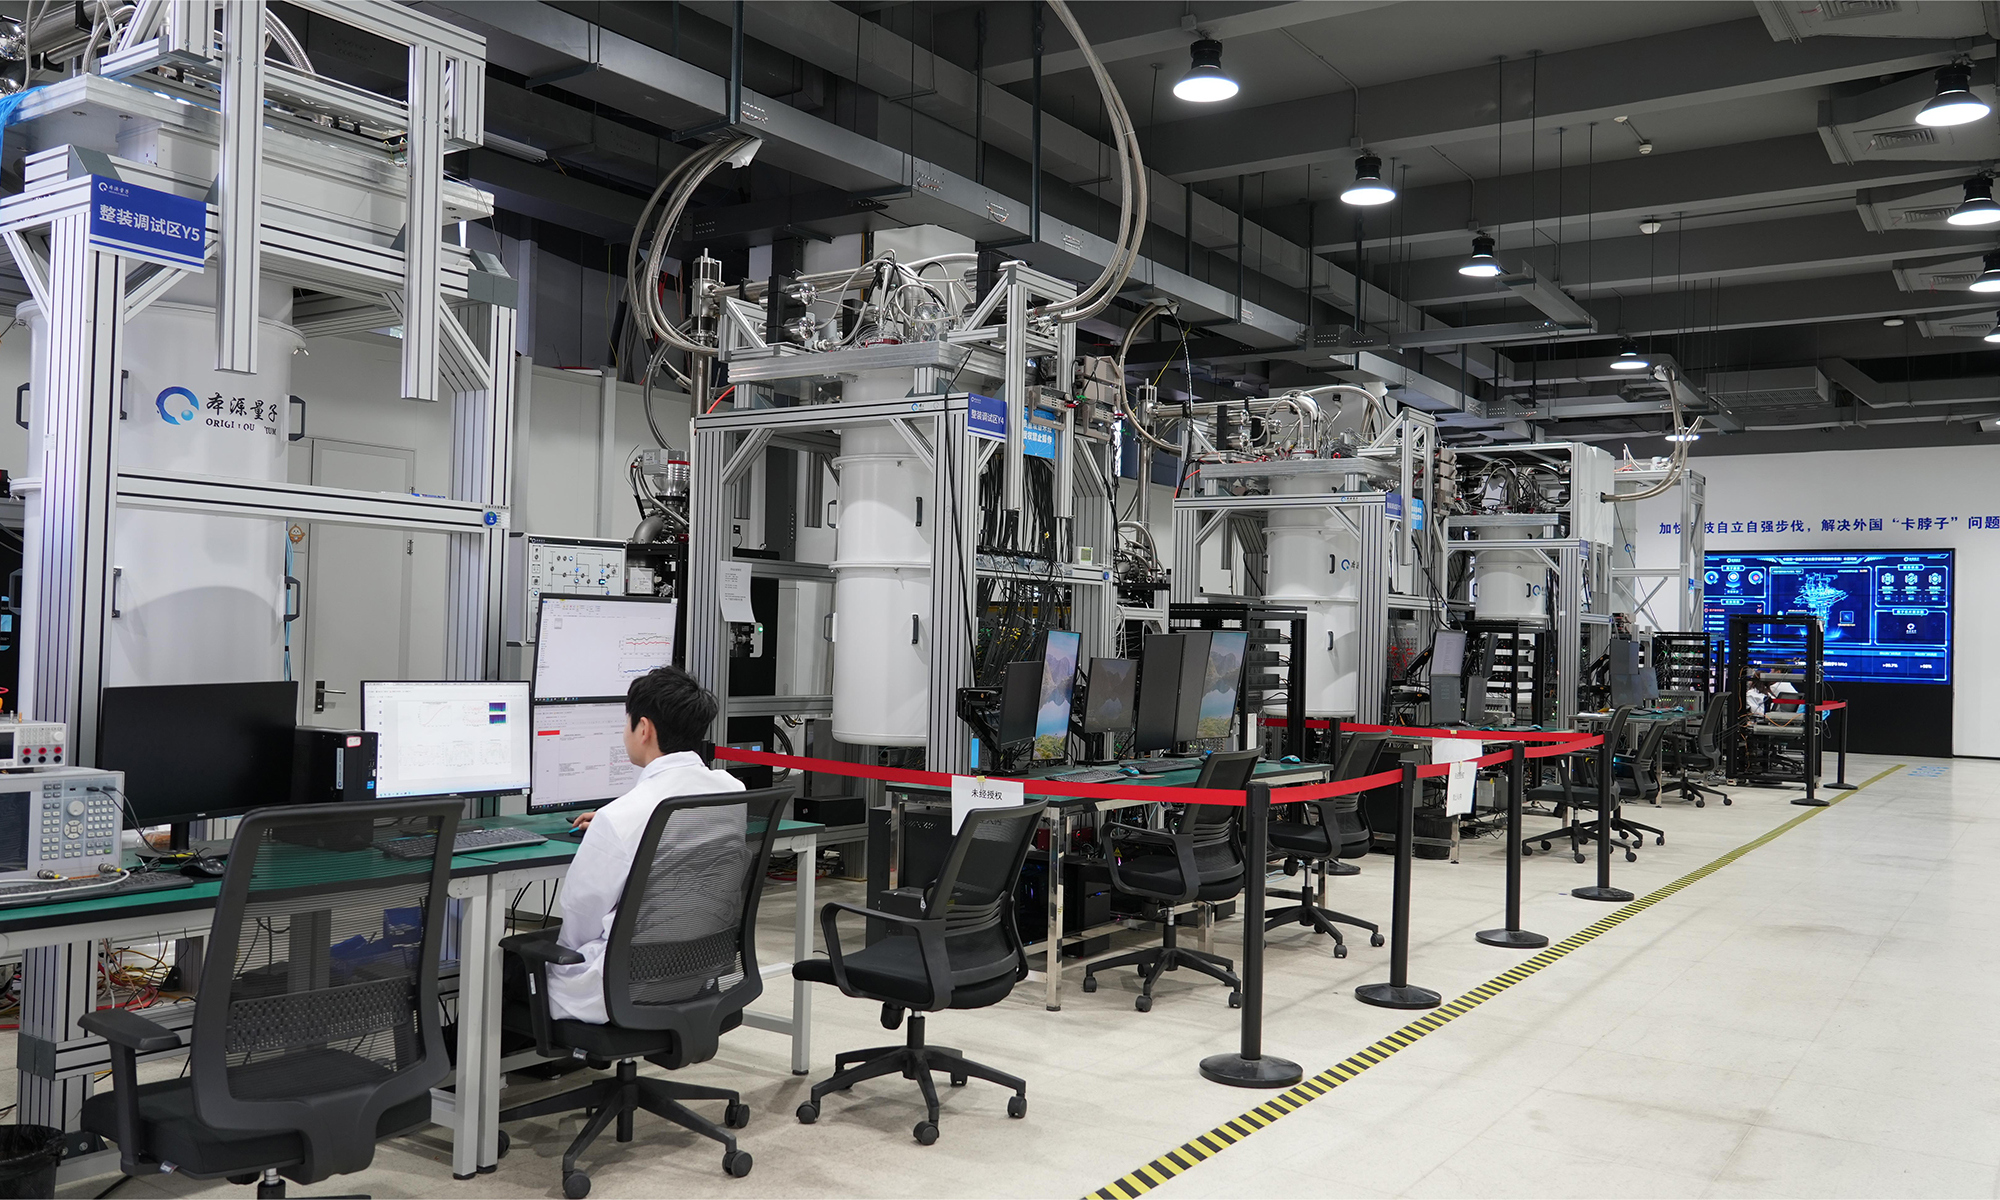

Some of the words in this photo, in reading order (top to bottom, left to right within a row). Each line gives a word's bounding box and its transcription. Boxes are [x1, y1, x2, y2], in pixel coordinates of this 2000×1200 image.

[99, 204, 201, 242] 整装调试区Y5
[206, 391, 278, 423] 本源量子
[205, 417, 241, 429] ORIGI
[971, 409, 1004, 425] 整装调试区Y4
[971, 788, 1003, 800] 未经授权
